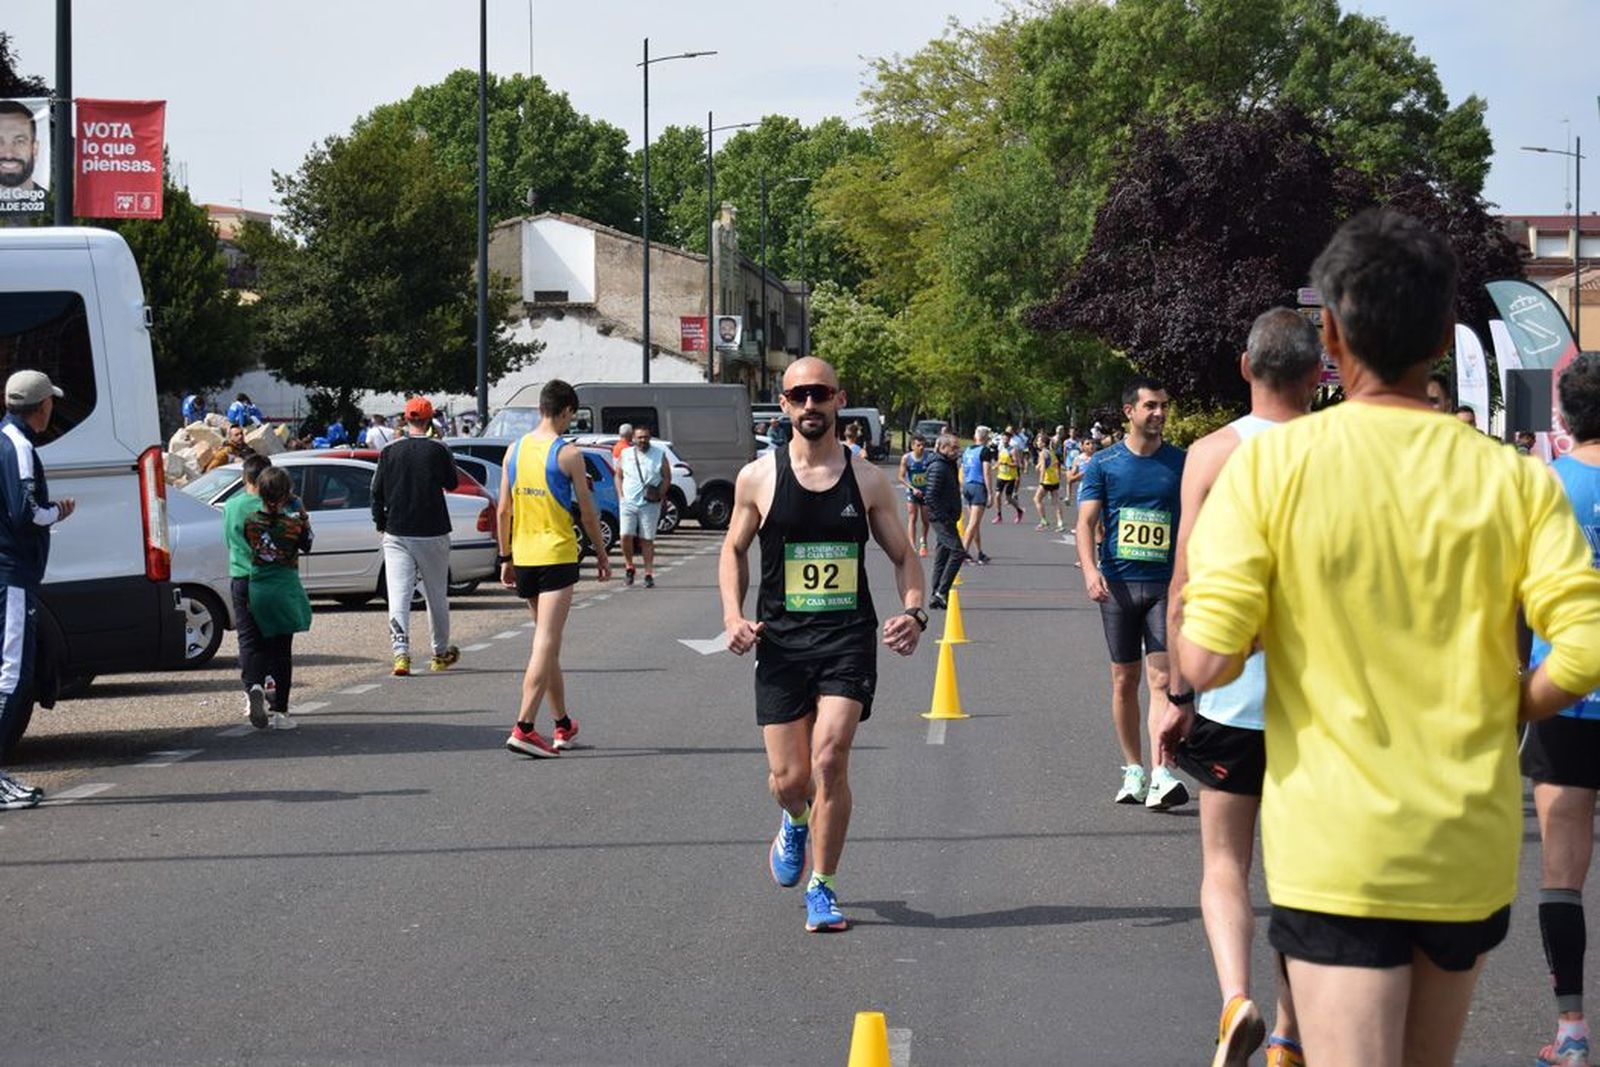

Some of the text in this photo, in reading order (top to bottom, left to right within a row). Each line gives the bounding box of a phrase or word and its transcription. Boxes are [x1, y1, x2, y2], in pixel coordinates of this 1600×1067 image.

[83, 122, 133, 138] VOTA
[83, 139, 136, 157] lo que
[83, 155, 156, 174] piensas.
[12, 188, 45, 201] Gago
[0, 201, 20, 211] LDE
[1123, 523, 1164, 546] 209
[803, 563, 839, 590] 92
